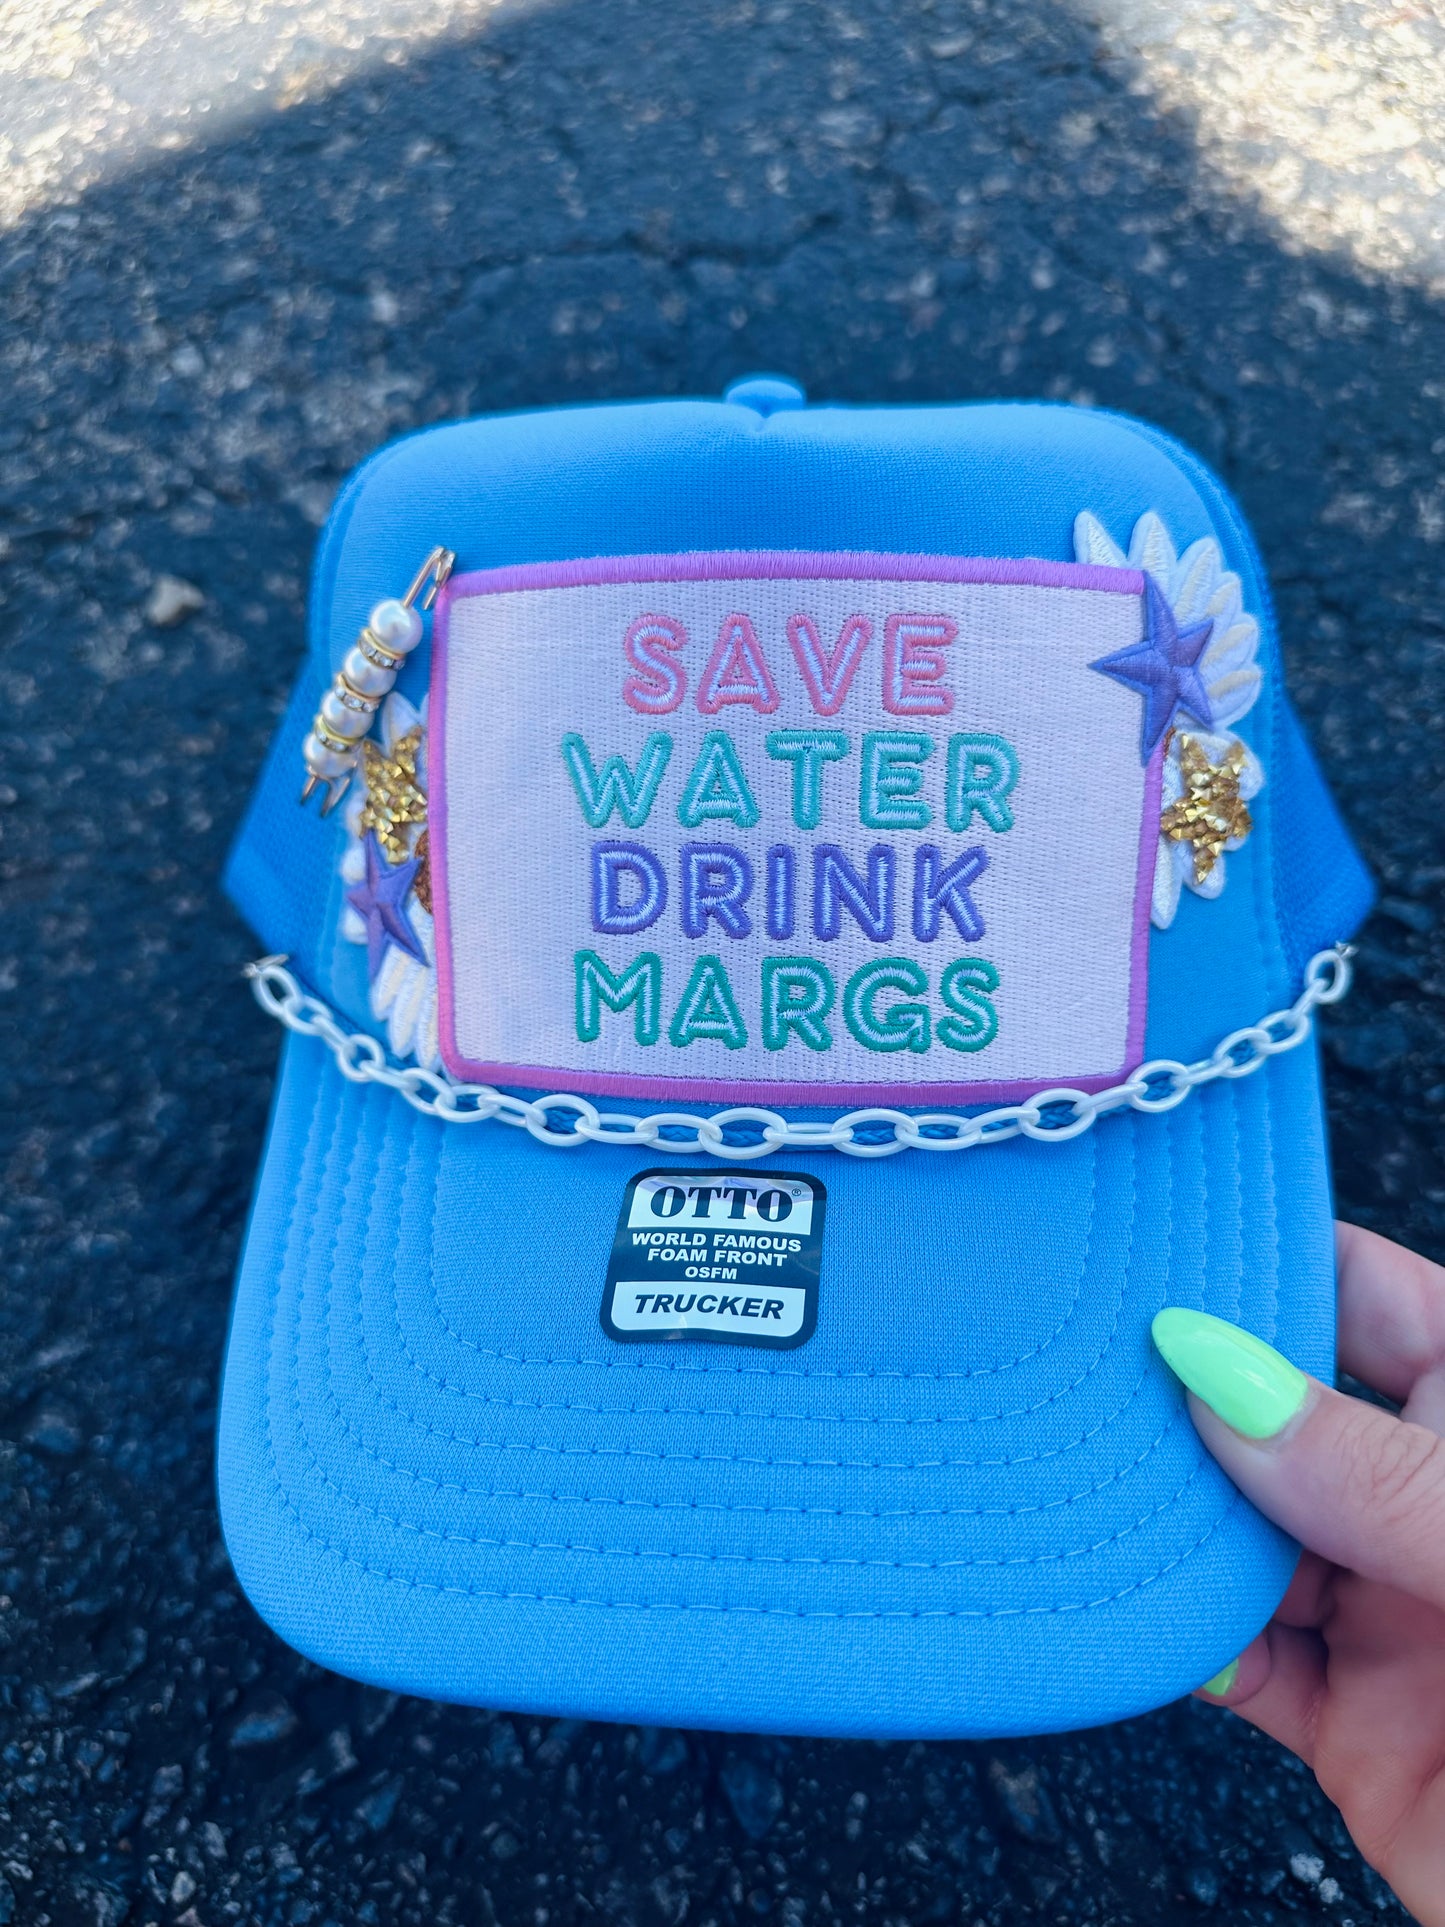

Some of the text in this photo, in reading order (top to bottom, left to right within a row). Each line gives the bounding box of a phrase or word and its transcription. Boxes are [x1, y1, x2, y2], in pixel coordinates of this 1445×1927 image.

[623, 612, 959, 716] SAVE
[561, 729, 1021, 833] WATER
[591, 840, 990, 943] DRINK
[573, 949, 1000, 1054] MARGS
[632, 1232, 802, 1253] WORLD FAMOUS
[647, 1248, 788, 1267] FOAM FRONT
[684, 1266, 737, 1280] OSFM
[635, 1294, 785, 1320] TRUCKER
